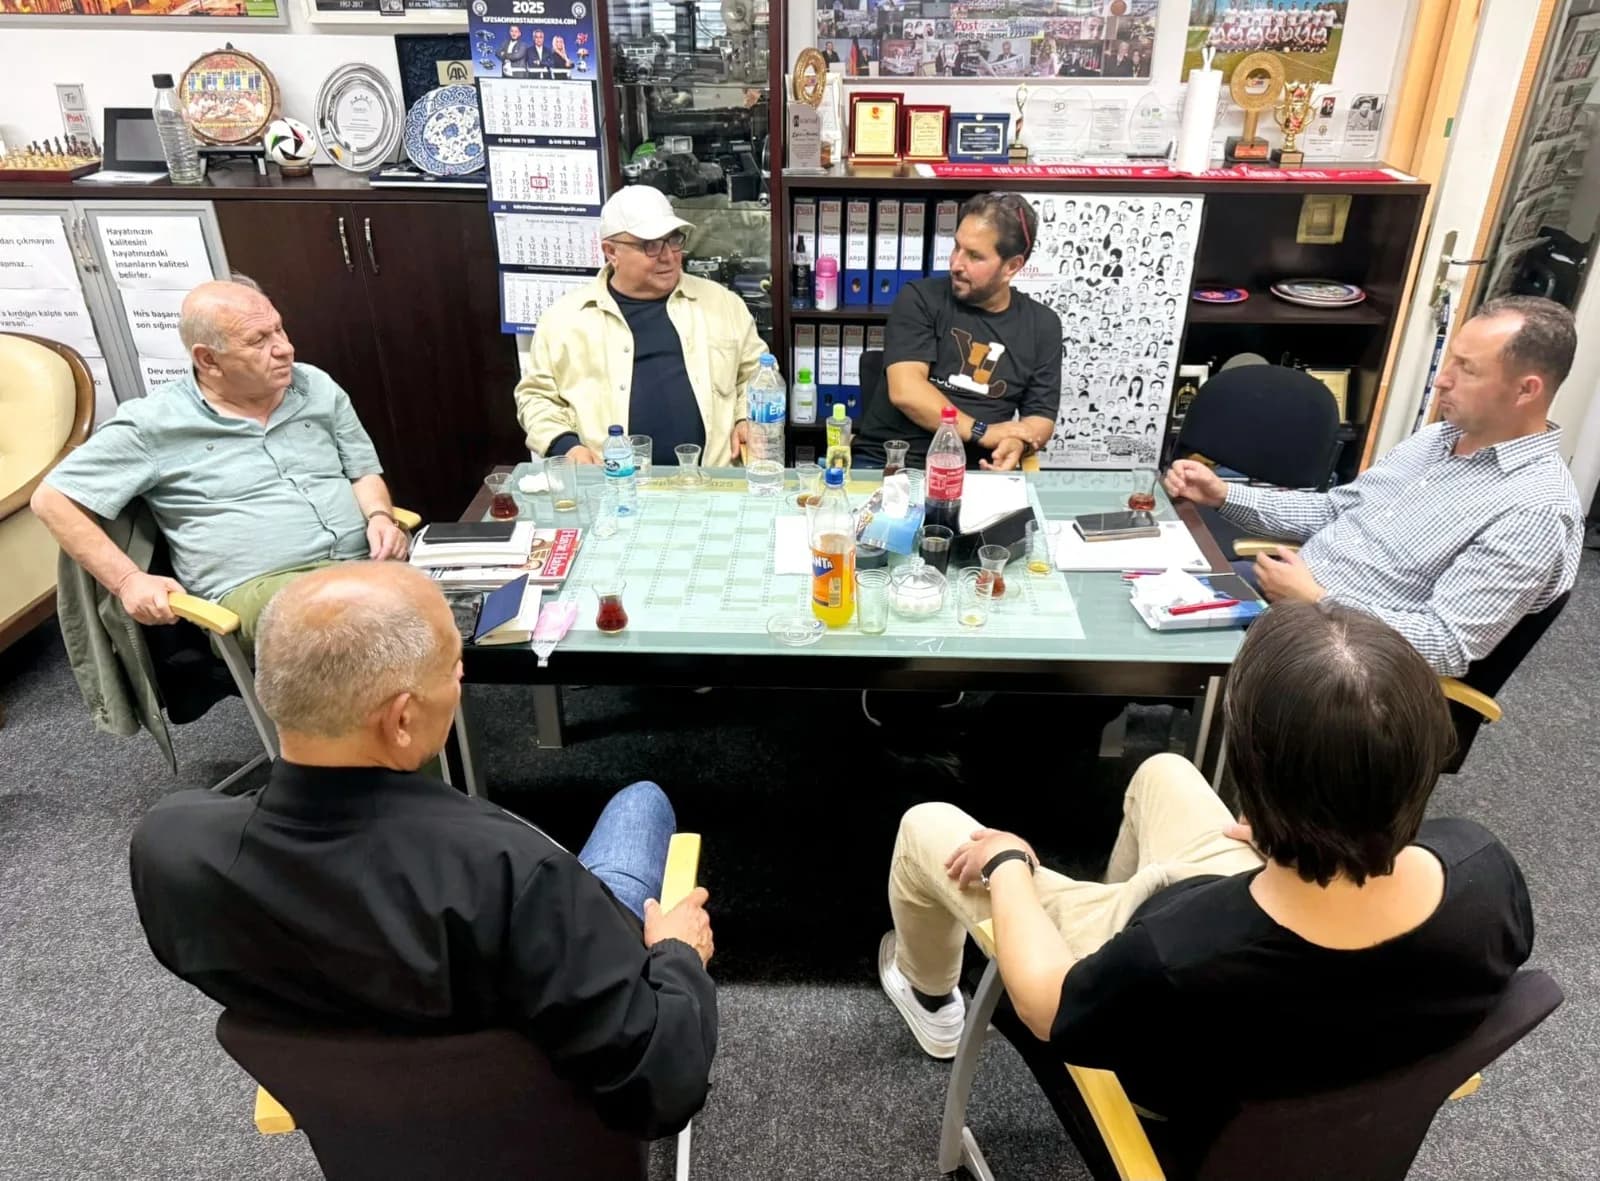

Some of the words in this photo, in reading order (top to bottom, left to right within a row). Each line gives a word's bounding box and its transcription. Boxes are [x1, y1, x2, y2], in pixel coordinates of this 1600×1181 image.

[512, 2, 544, 14] 2025
[106, 228, 153, 237] Hayatınızın
[110, 238, 147, 246] kalitesini
[112, 249, 168, 258] hayatınızdaki
[116, 260, 157, 268] insanların
[158, 260, 189, 269] kalitesi
